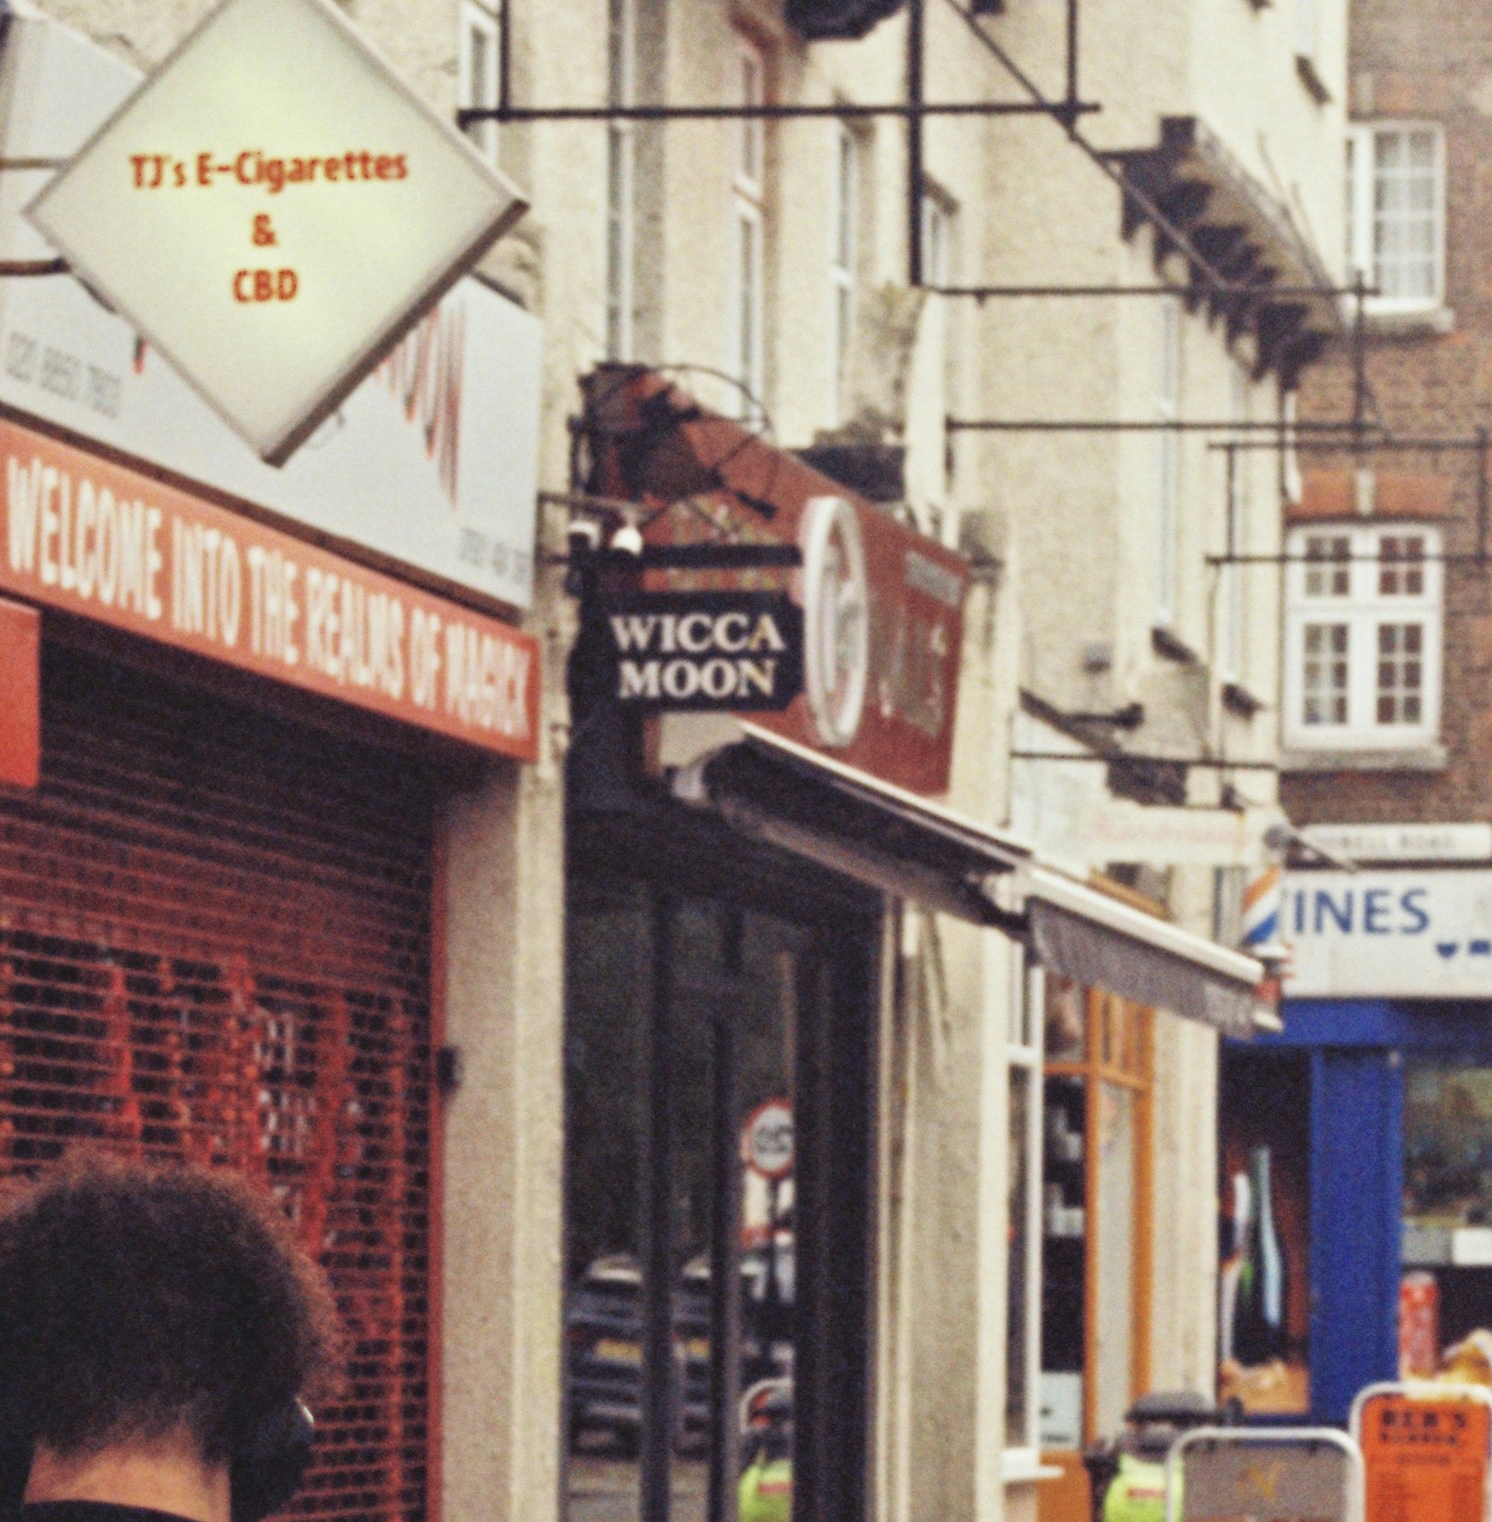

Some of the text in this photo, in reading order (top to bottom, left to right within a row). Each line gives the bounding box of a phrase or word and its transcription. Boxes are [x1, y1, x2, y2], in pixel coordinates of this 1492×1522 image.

[129, 150, 409, 193] TJ's E-Cigarettes
[251, 213, 278, 247] &
[231, 268, 300, 304] CBD
[8, 456, 162, 621] WELCOME
[171, 514, 242, 648] INTO
[248, 546, 300, 667] THE
[307, 566, 406, 700] REALMS
[410, 608, 440, 709] OF
[609, 612, 787, 652] WICCA
[618, 658, 779, 699] MOON
[1283, 887, 1430, 936] INES
